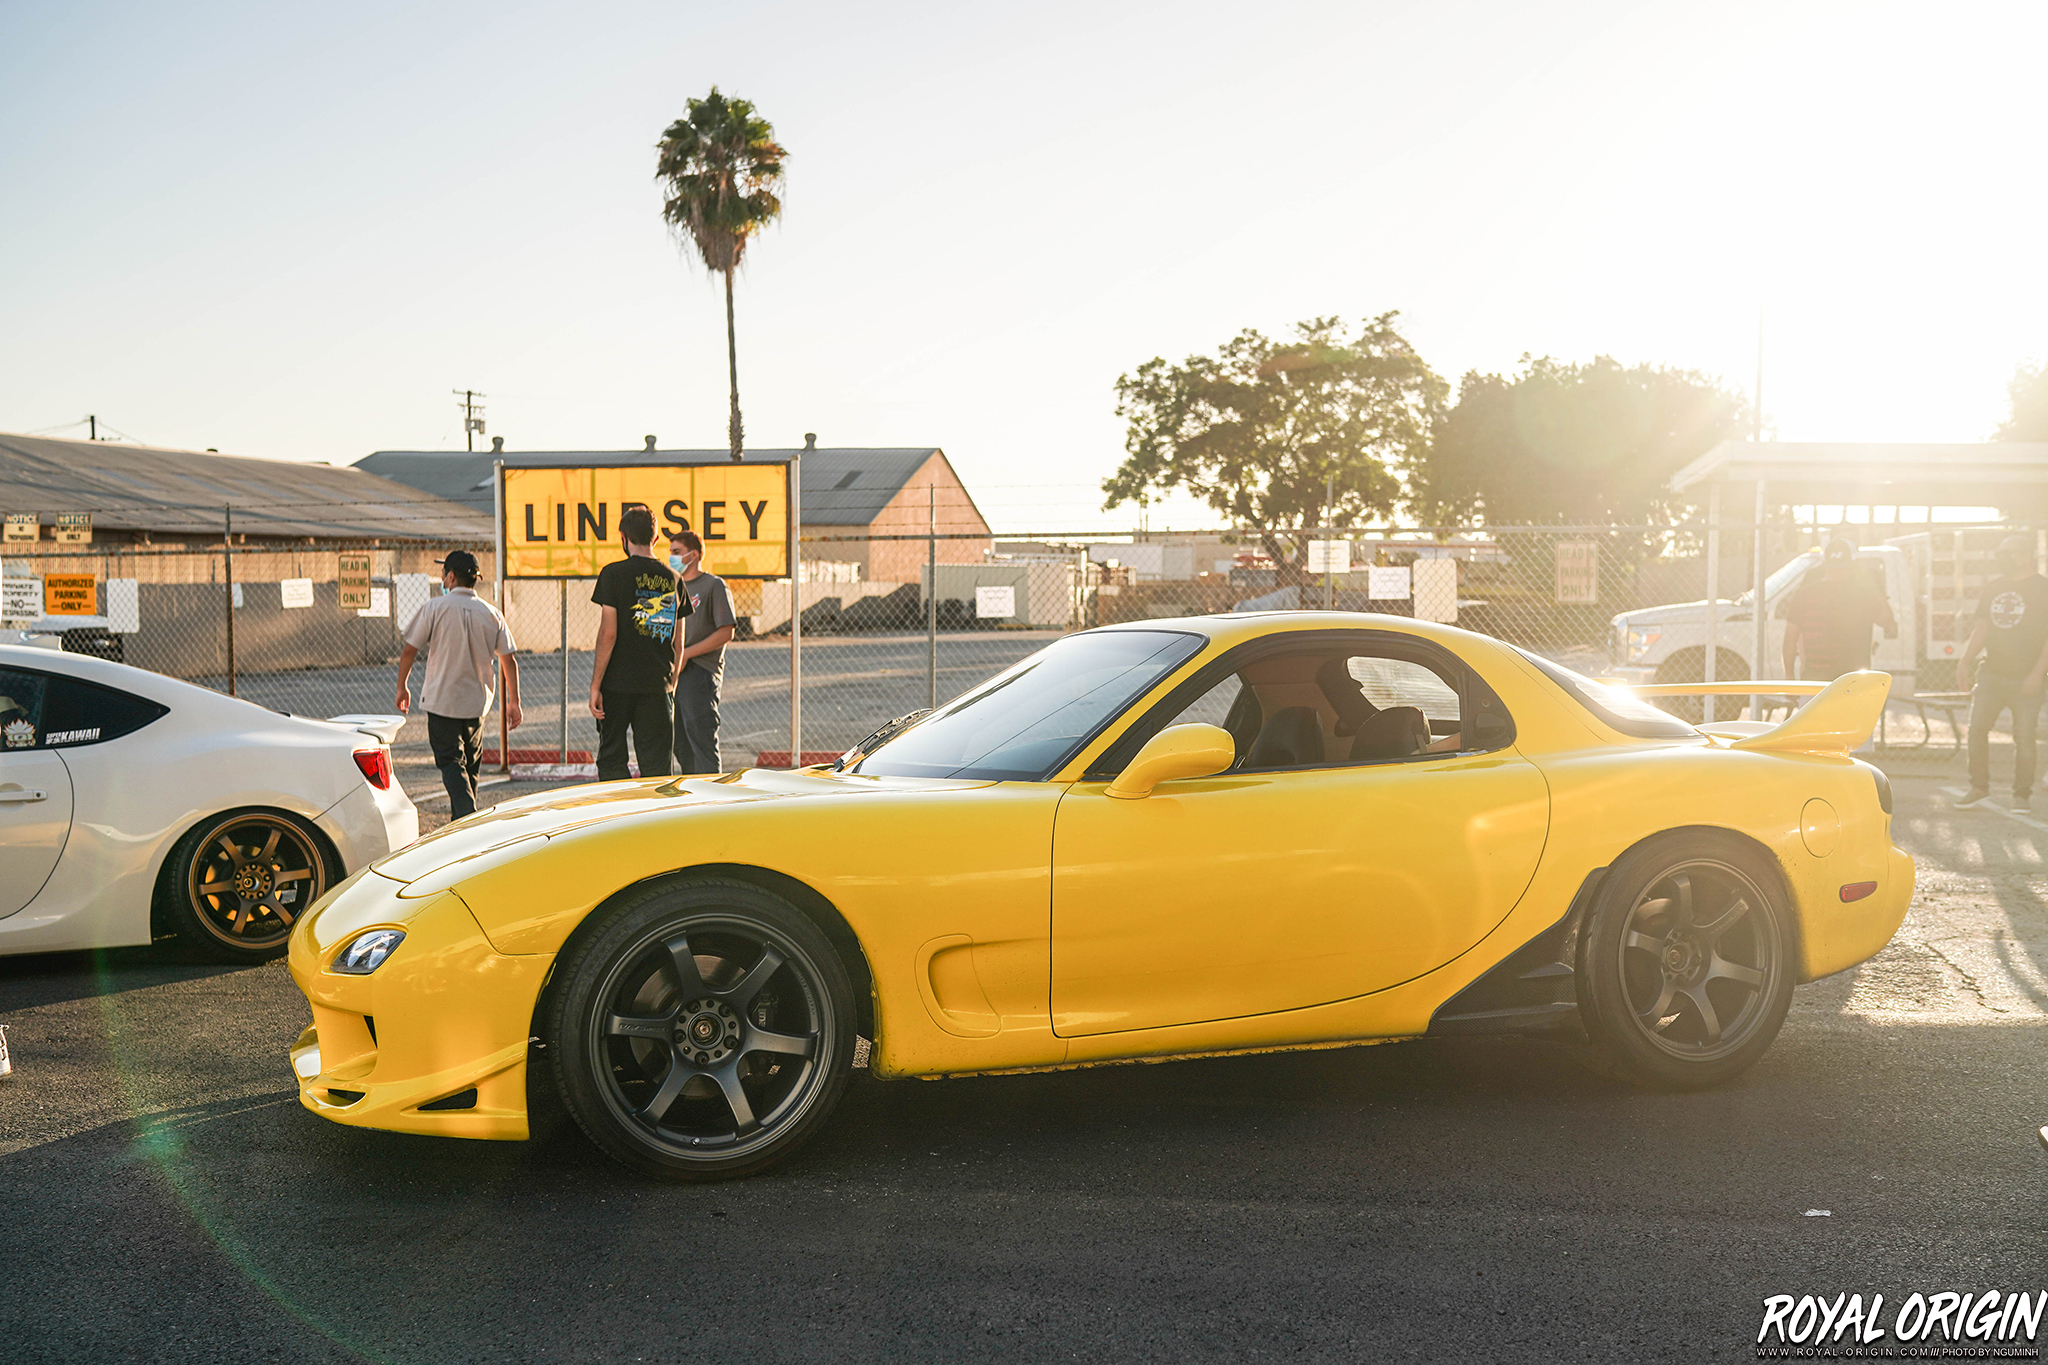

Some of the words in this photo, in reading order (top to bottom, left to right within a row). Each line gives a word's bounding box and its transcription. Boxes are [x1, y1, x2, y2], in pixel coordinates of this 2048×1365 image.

[6, 514, 37, 524] NOTICE
[59, 515, 89, 524] NOTICE
[525, 500, 768, 542] LINSEY
[341, 561, 360, 571] HEAD
[361, 561, 368, 571] IN
[47, 579, 95, 588] AUTHORIZED
[342, 577, 368, 587] PARKING
[54, 590, 88, 600] PARKING
[1562, 585, 1592, 597] ONLY
[343, 593, 367, 604] ONLY
[10, 599, 25, 609] NO
[60, 602, 82, 611] ONLY
[61, 728, 100, 742] KAWAII
